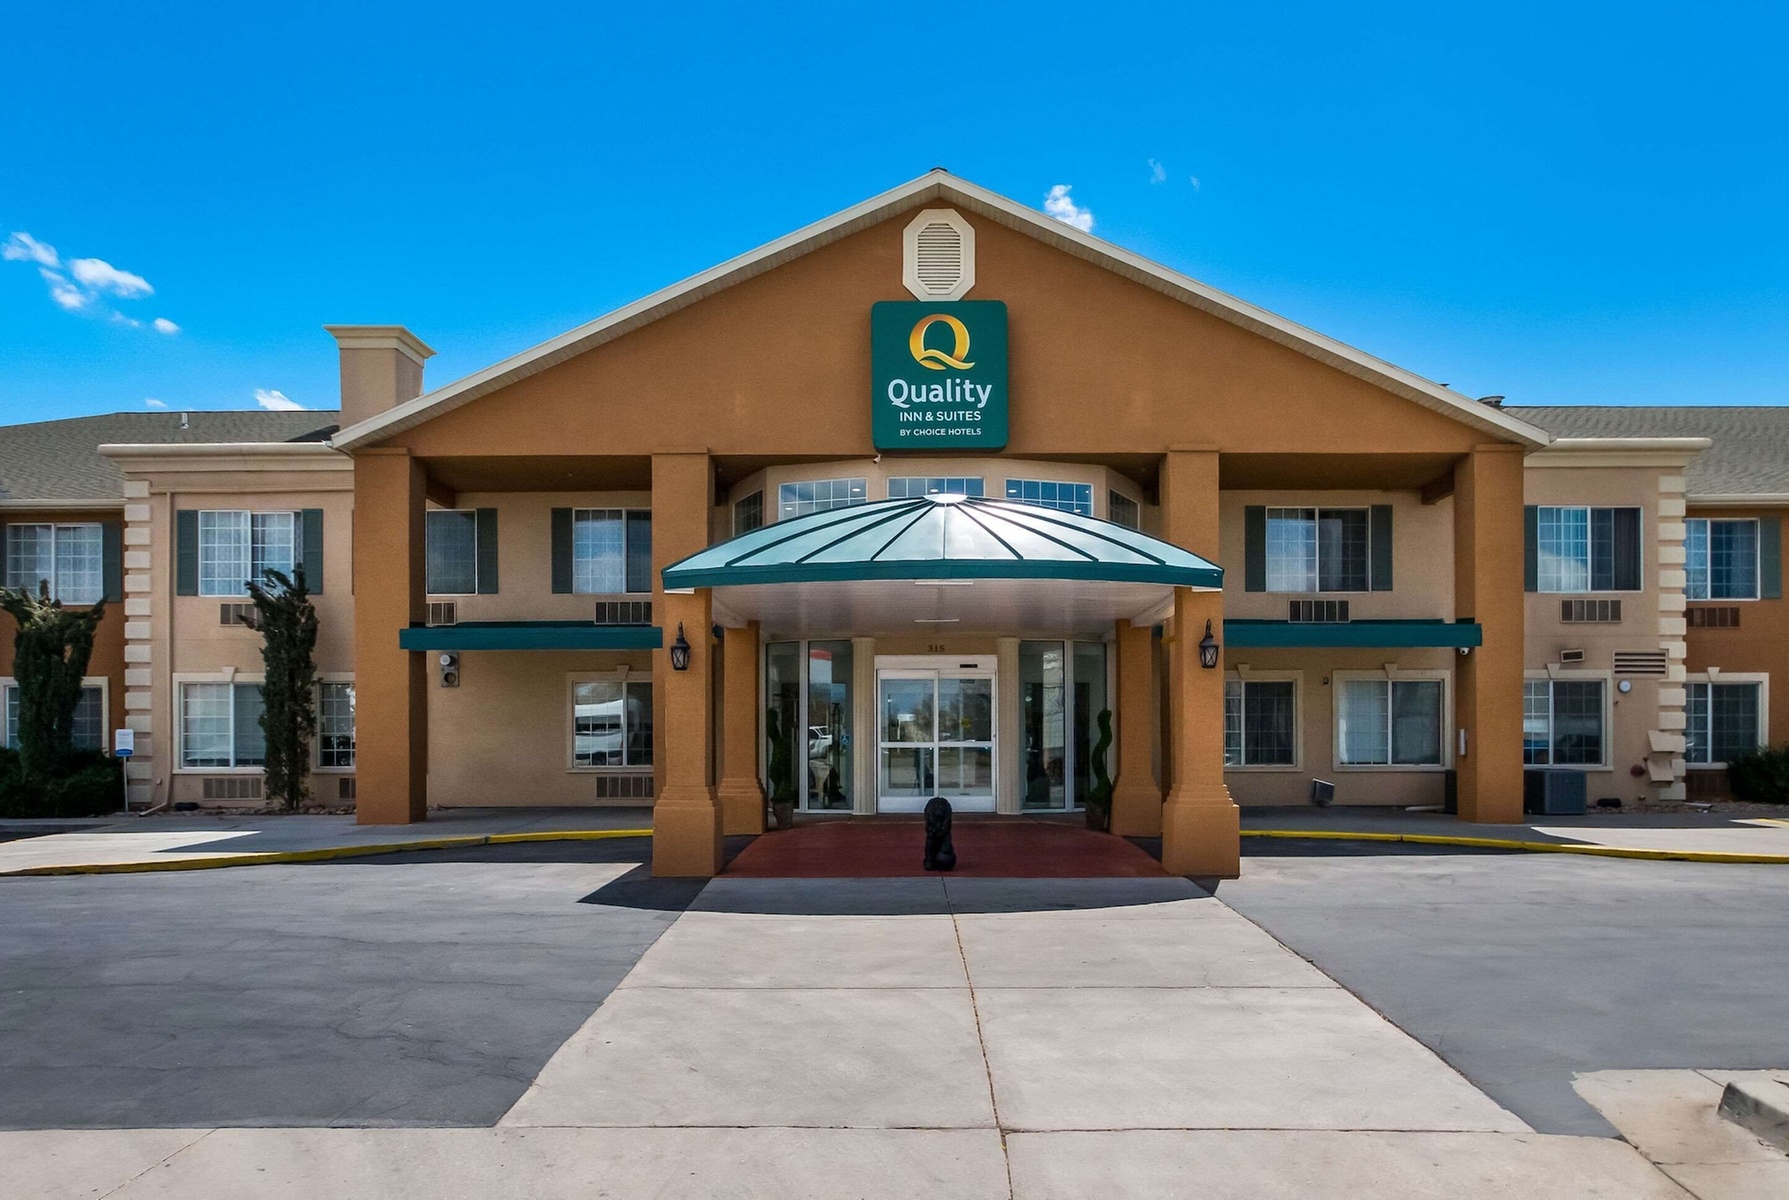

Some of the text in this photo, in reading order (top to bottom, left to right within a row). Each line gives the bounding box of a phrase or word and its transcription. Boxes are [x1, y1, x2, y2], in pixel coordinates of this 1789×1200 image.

[909, 313, 975, 370] Q
[887, 378, 992, 408] Quality
[900, 411, 981, 422] INN & SUITES
[900, 428, 982, 436] BY CHOICE HOTELS
[927, 644, 945, 653] 315
